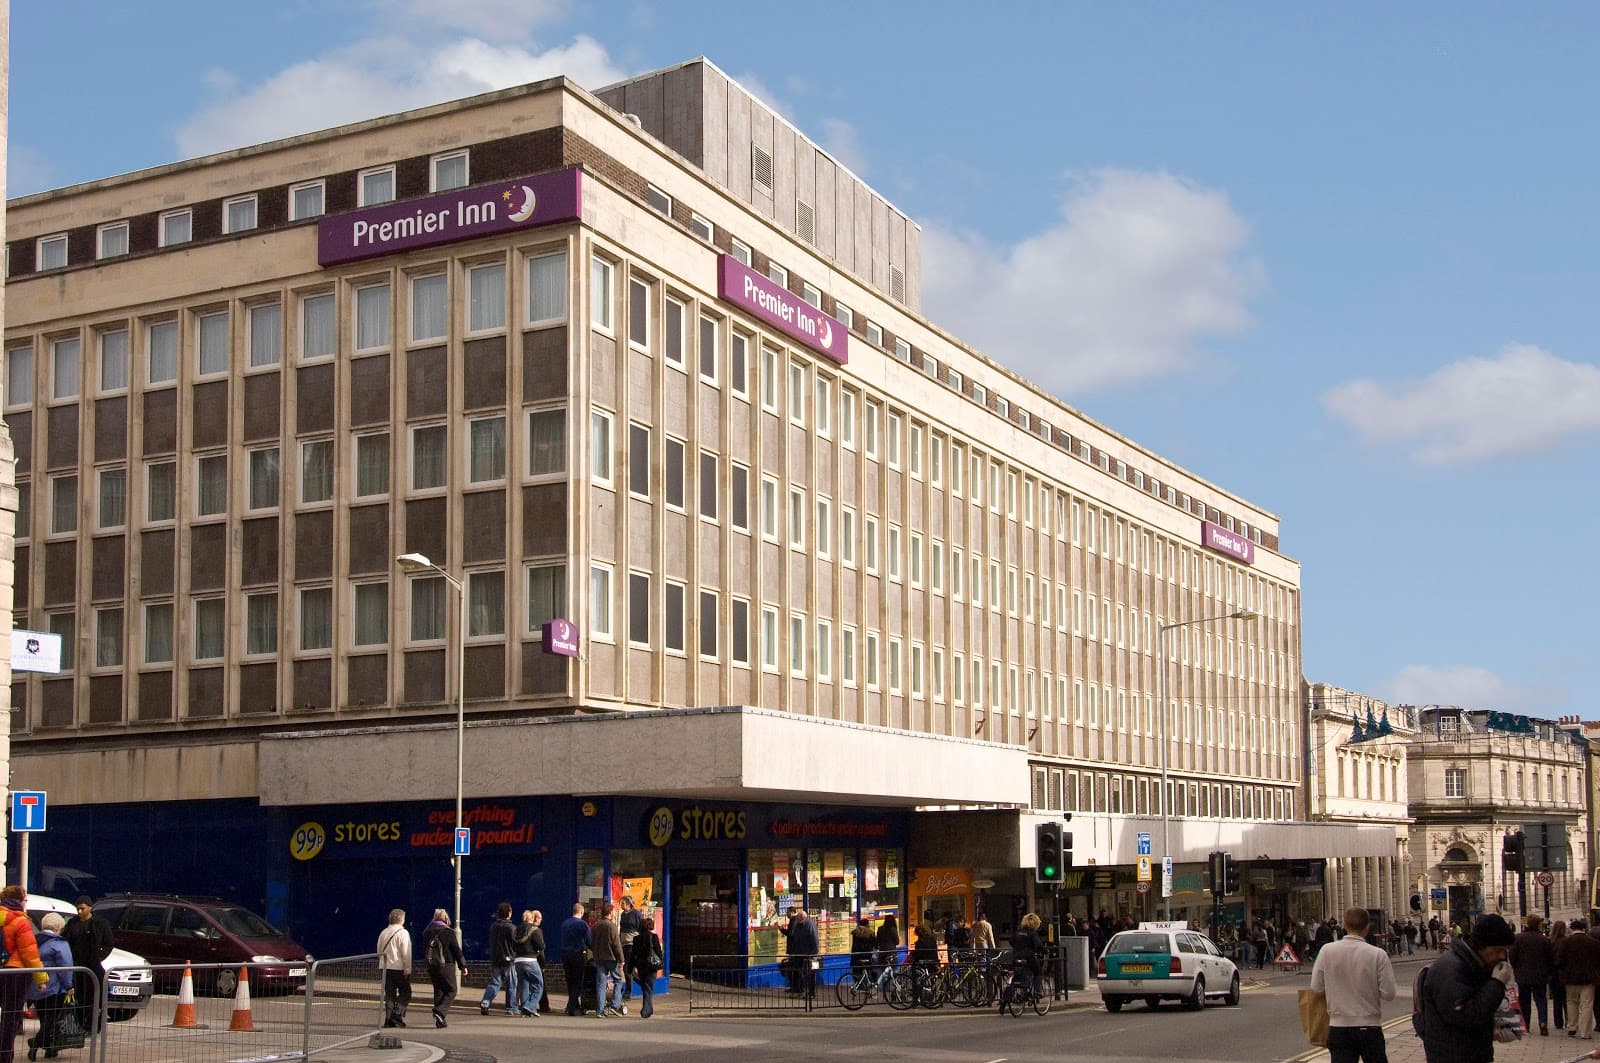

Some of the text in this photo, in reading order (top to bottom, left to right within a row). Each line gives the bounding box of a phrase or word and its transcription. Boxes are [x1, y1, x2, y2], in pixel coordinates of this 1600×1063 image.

[353, 200, 496, 247] Premier Inn
[744, 274, 815, 337] Premier Inn
[428, 806, 516, 825] eveything
[681, 806, 747, 839] stores
[296, 821, 401, 854] 99p stores
[1540, 875, 1552, 883] 20
